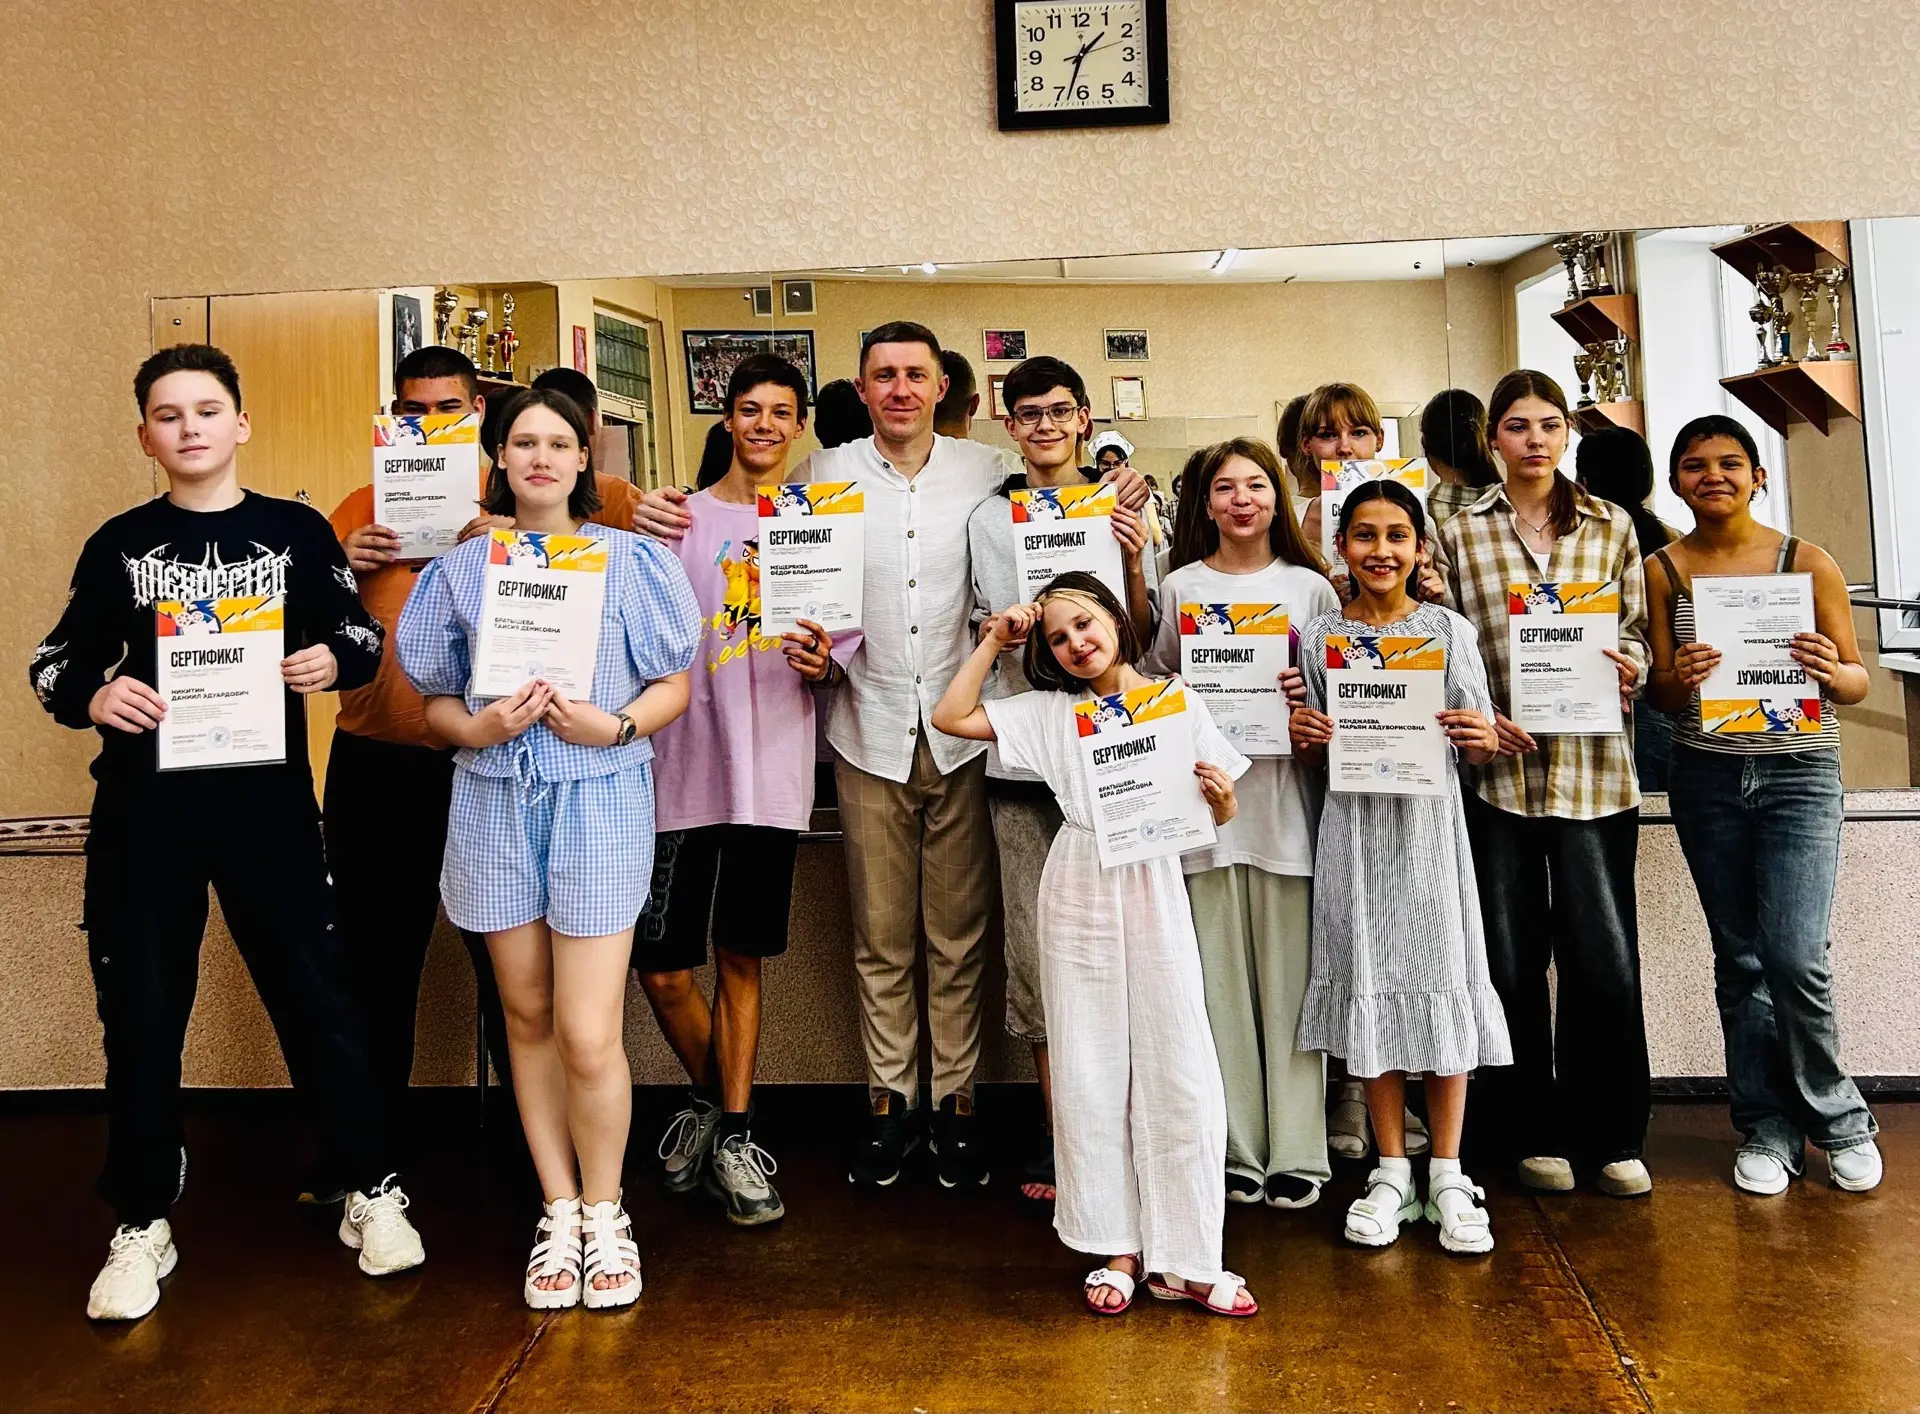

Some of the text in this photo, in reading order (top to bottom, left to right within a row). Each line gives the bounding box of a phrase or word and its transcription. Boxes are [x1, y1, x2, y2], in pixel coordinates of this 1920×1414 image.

[1047, 14, 1062, 28] 11
[1071, 12, 1090, 28] 12
[1101, 12, 1108, 26] 1
[1026, 27, 1045, 42] 10
[1121, 23, 1132, 38] 2
[1029, 50, 1042, 65] 9
[1122, 47, 1134, 62] 3
[1031, 76, 1044, 91] 8
[1121, 72, 1136, 86] 4
[1053, 86, 1066, 101] 7
[1076, 86, 1089, 100] 6
[1102, 84, 1114, 98] 5
[384, 458, 446, 473] СЕРТИФИКАТ
[770, 528, 832, 545] СЕРТИФИКАТ
[1025, 532, 1086, 550] СЕРТИФИКАТ
[498, 580, 568, 600] СЕРТИФИКАТ
[495, 617, 534, 625] БРАТЫШЕВА
[1520, 628, 1584, 643] СЕРТИФИКАТ
[171, 648, 244, 667] СЕРТИФИКАТ
[1191, 648, 1255, 663] СЕРТИФИКАТ
[1737, 670, 1807, 685] СЕРТИФИКАТ
[203, 691, 249, 699] ЭДУАРДОВИЧ
[1339, 683, 1407, 699] СЕРТИФИКАТ
[1093, 735, 1157, 765] СЕРТИФИКАТ
[1099, 779, 1136, 793] БРАТЫШЕВА
[1115, 781, 1153, 795] ДЕНИСОВНА
